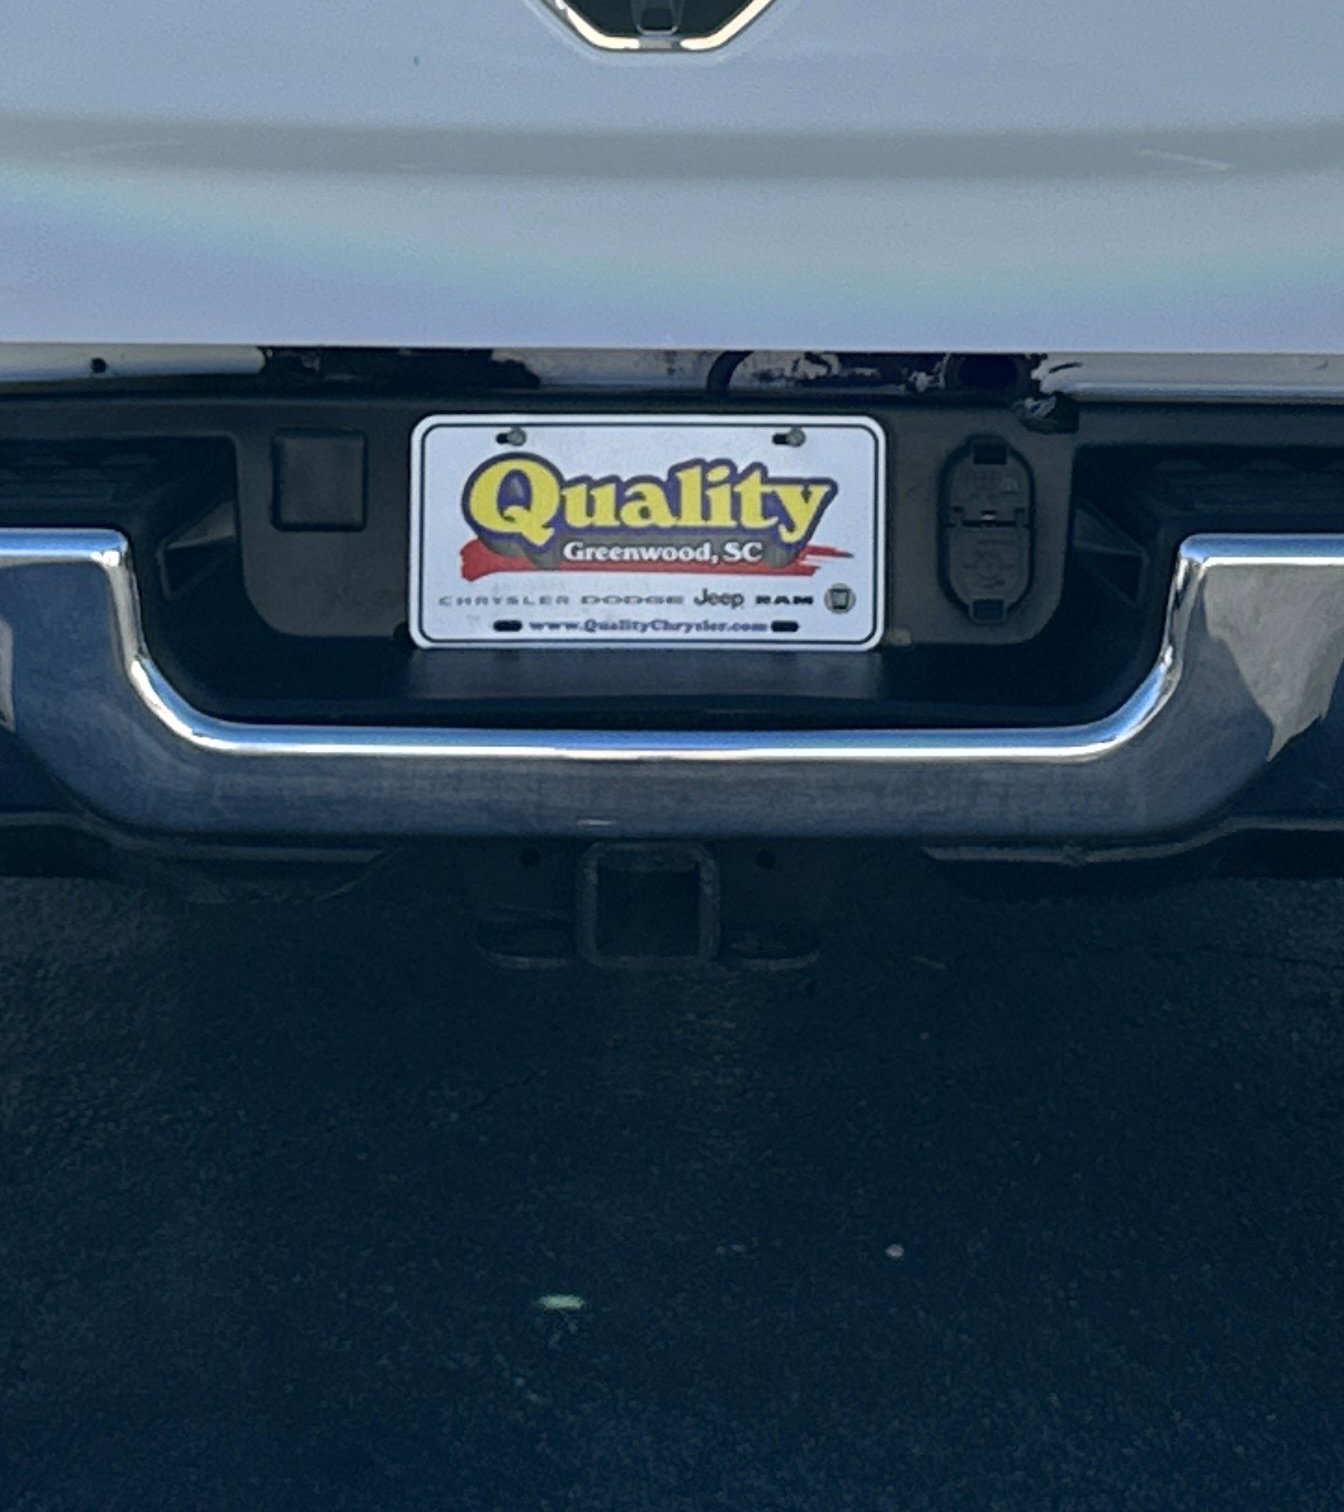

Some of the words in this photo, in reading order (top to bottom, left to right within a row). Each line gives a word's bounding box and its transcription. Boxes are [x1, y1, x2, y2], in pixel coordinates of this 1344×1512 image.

[464, 454, 836, 550] Quality
[563, 541, 719, 564] Greenwood,
[723, 541, 763, 562] SC
[438, 595, 570, 606] CHRYSLER
[581, 595, 684, 605] DODGE
[694, 588, 744, 609] Jeep
[756, 595, 814, 605] RAM
[529, 618, 769, 634] www.QualityChrysler.com
